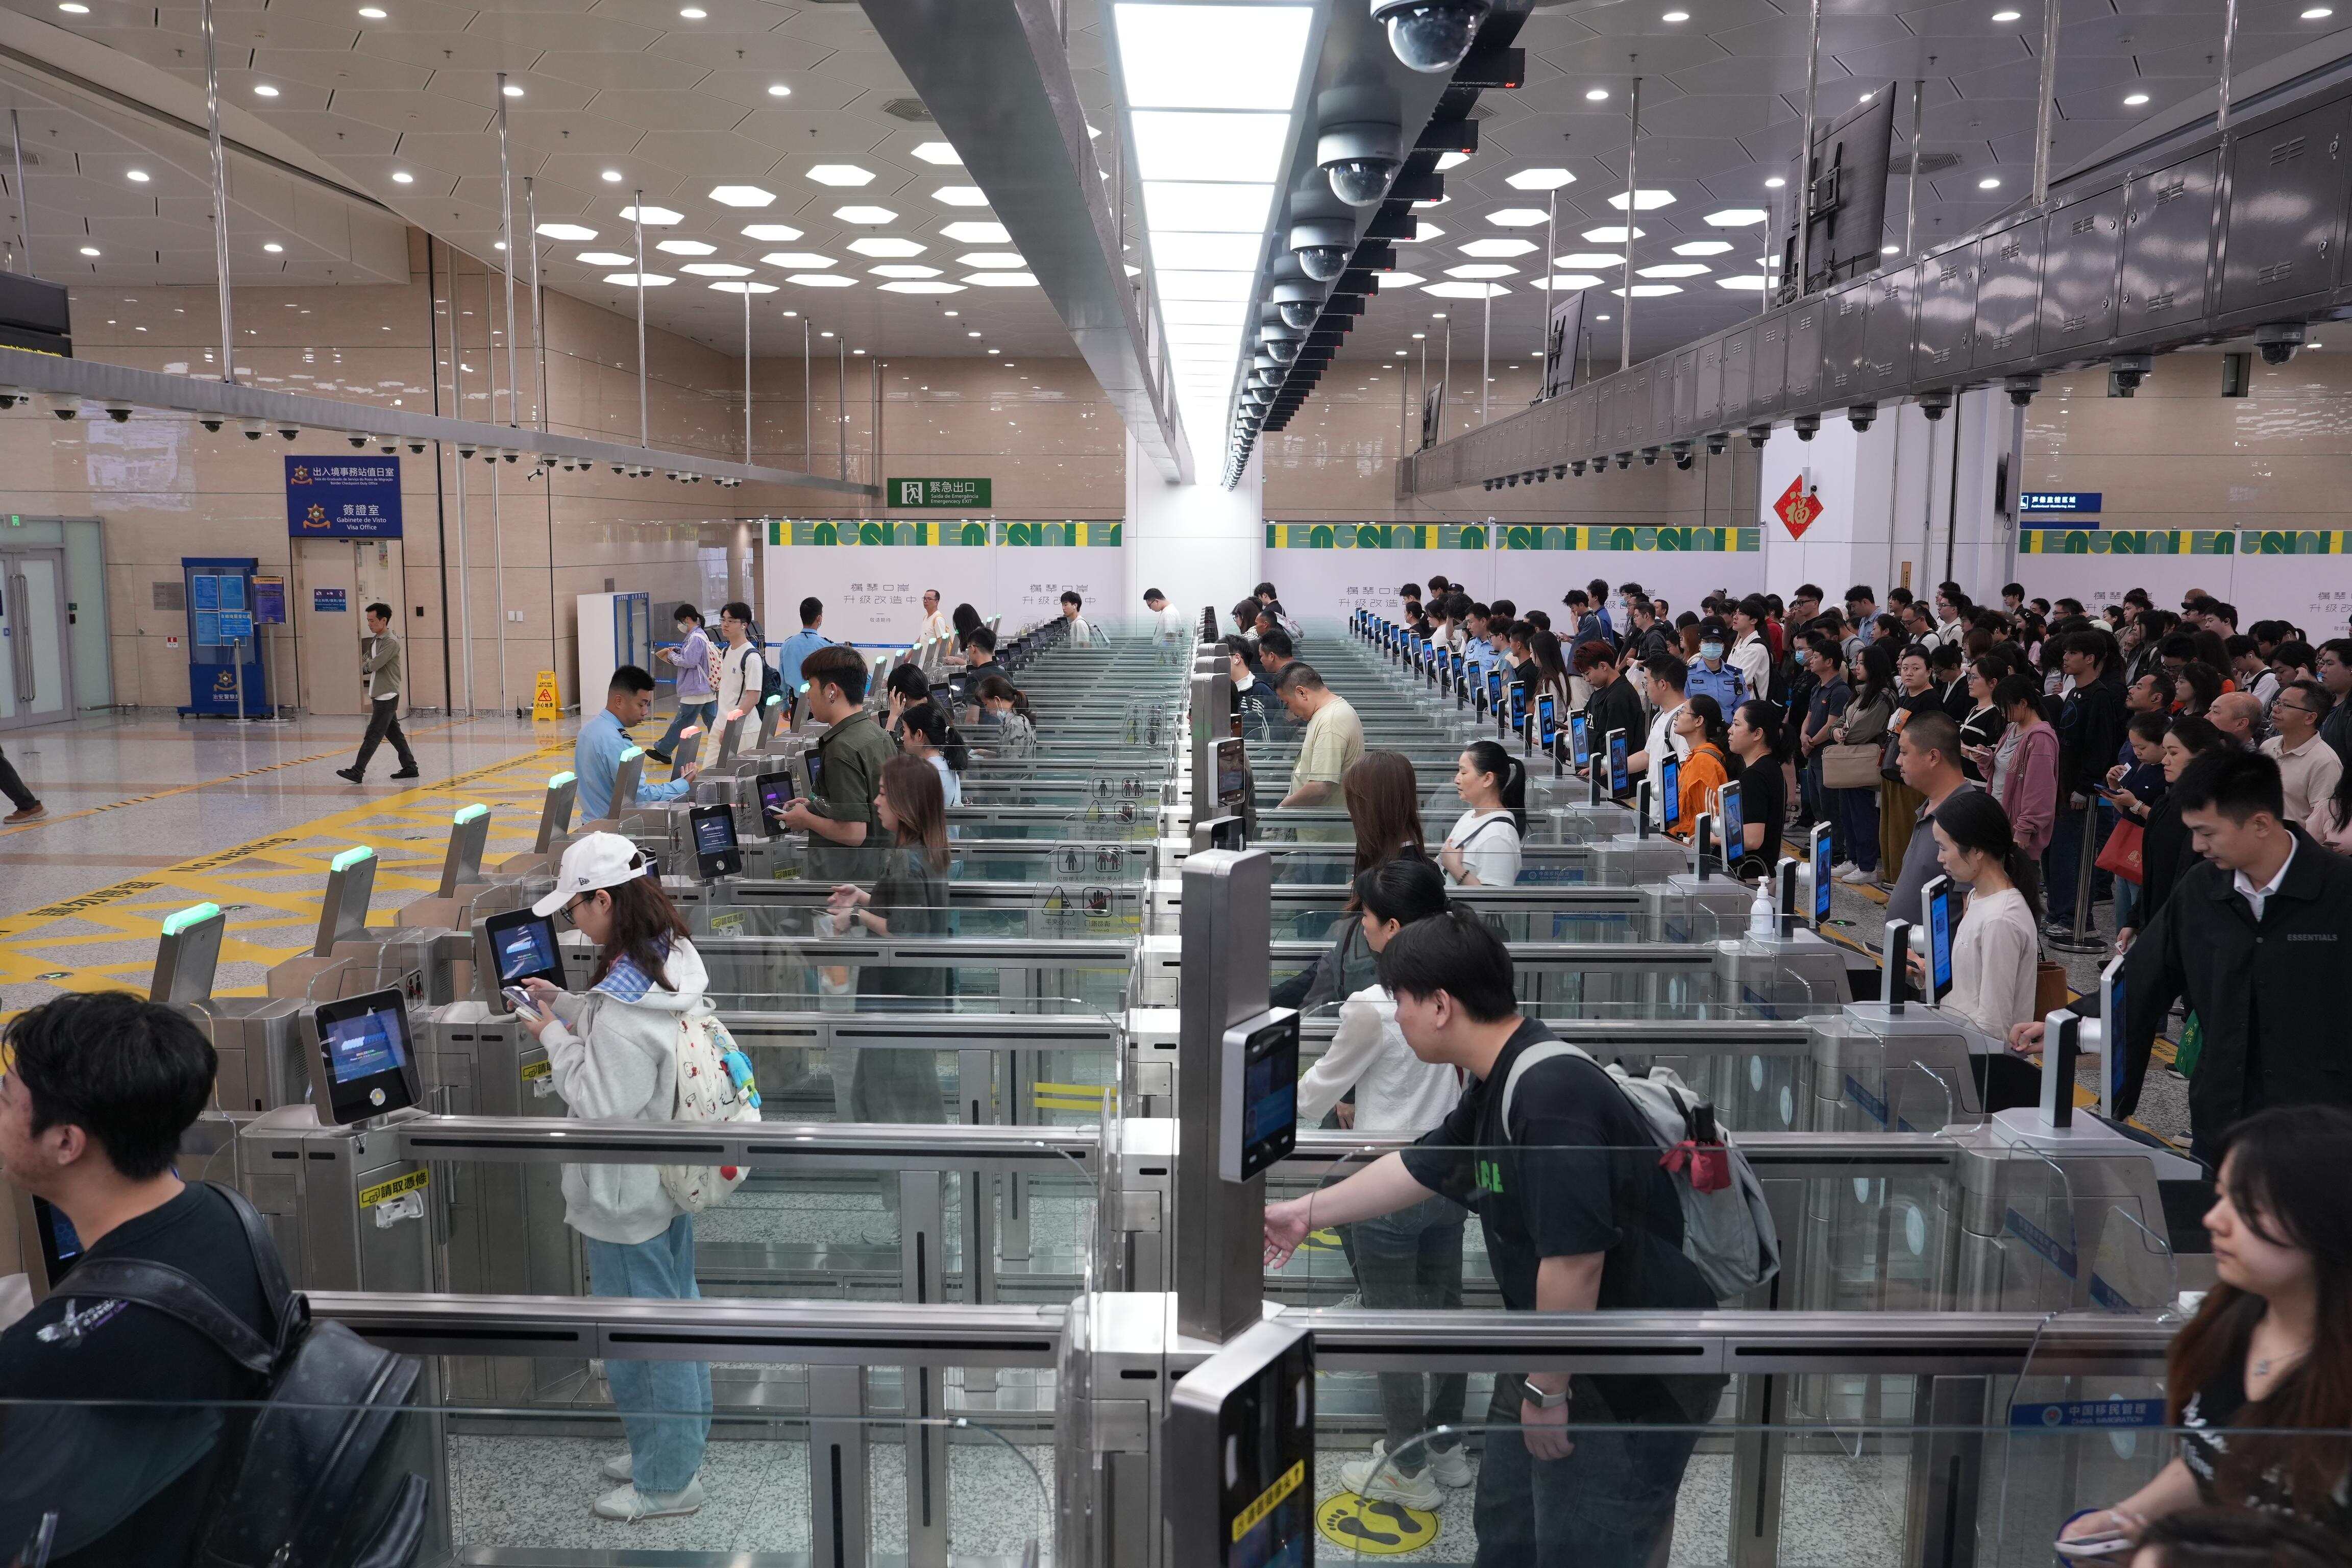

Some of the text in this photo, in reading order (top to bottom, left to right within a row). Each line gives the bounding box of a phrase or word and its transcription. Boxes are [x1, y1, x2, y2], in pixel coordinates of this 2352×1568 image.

[313, 467, 395, 477] 出入境事務站值日室
[930, 481, 975, 493] 緊急出口
[343, 504, 380, 516] 簽證室
[1785, 492, 1811, 524] 福
[844, 595, 917, 604] 升级改造中
[1022, 596, 1096, 605] 升级改中
[1339, 599, 1406, 607] 升级改造
[168, 837, 298, 872] No waiting
[381, 1172, 427, 1198] 請取憑條
[2069, 1404, 2146, 1416] 中国移民管理
